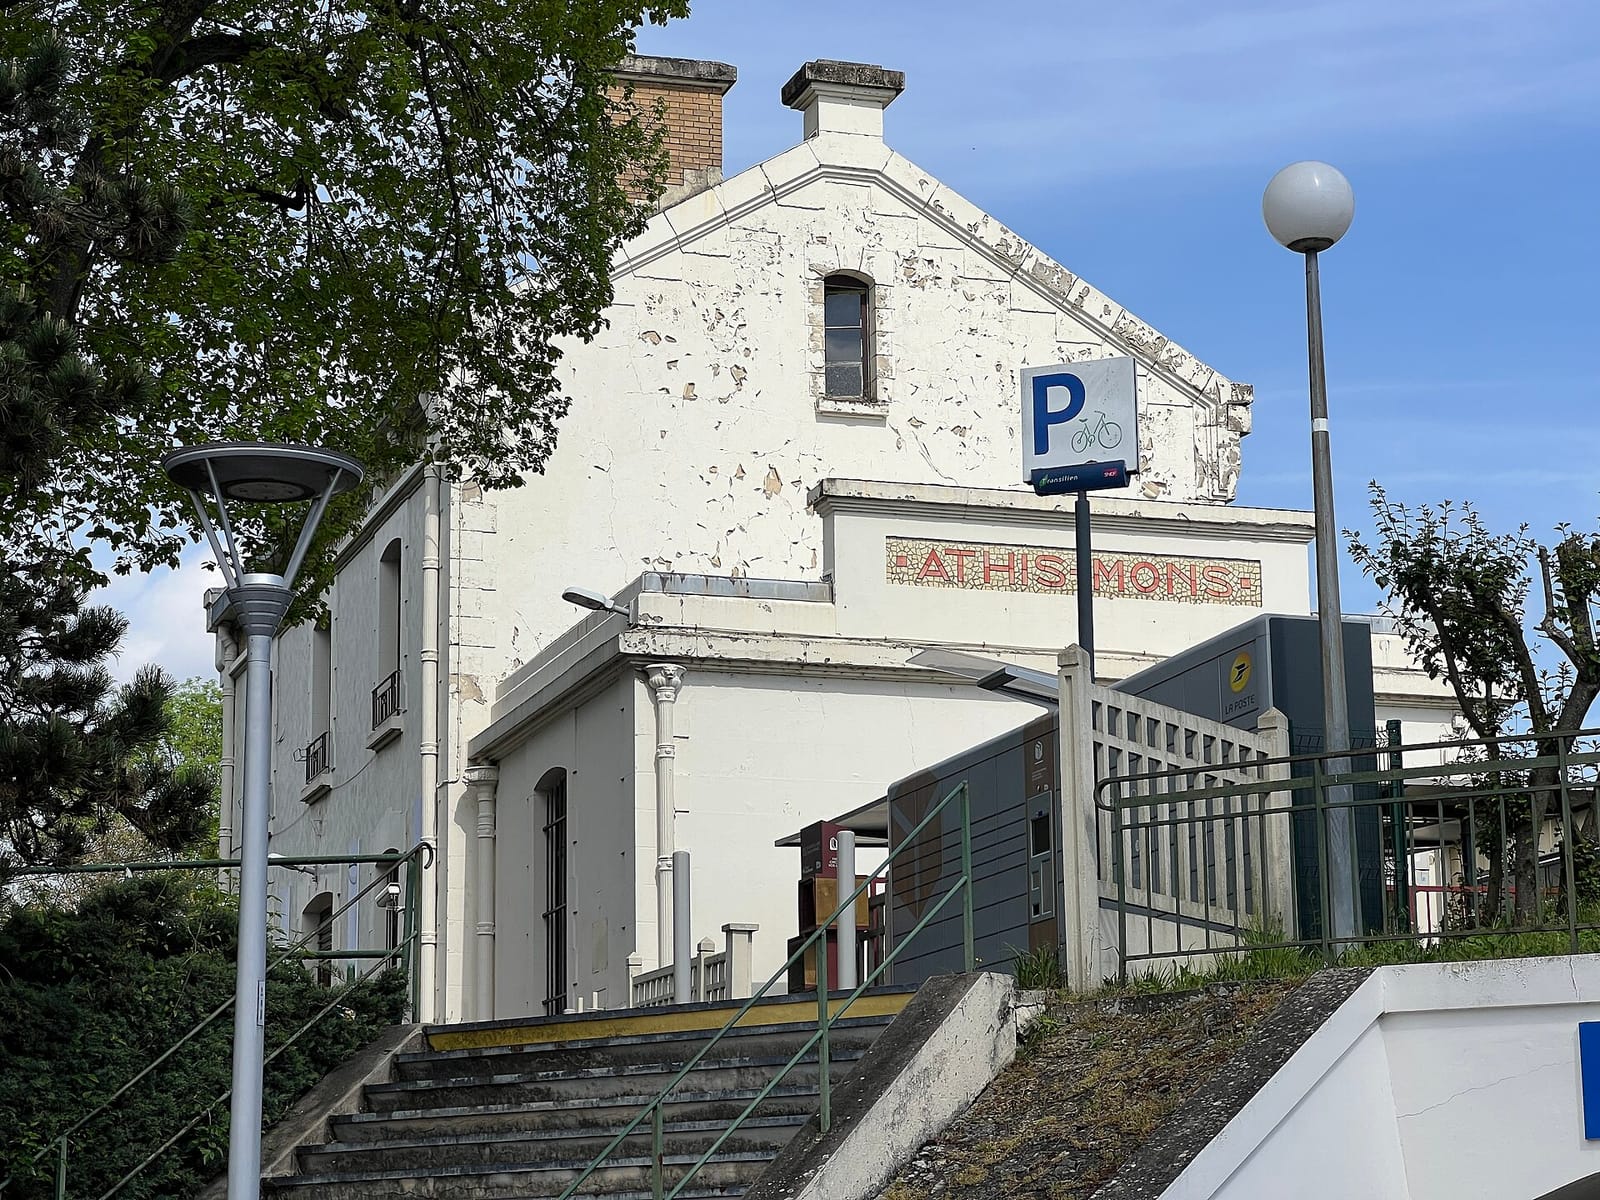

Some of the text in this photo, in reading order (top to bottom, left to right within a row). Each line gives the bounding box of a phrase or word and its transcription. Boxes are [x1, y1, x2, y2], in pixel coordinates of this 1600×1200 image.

[1032, 373, 1086, 456] P
[1225, 694, 1255, 714] LA POSTE
